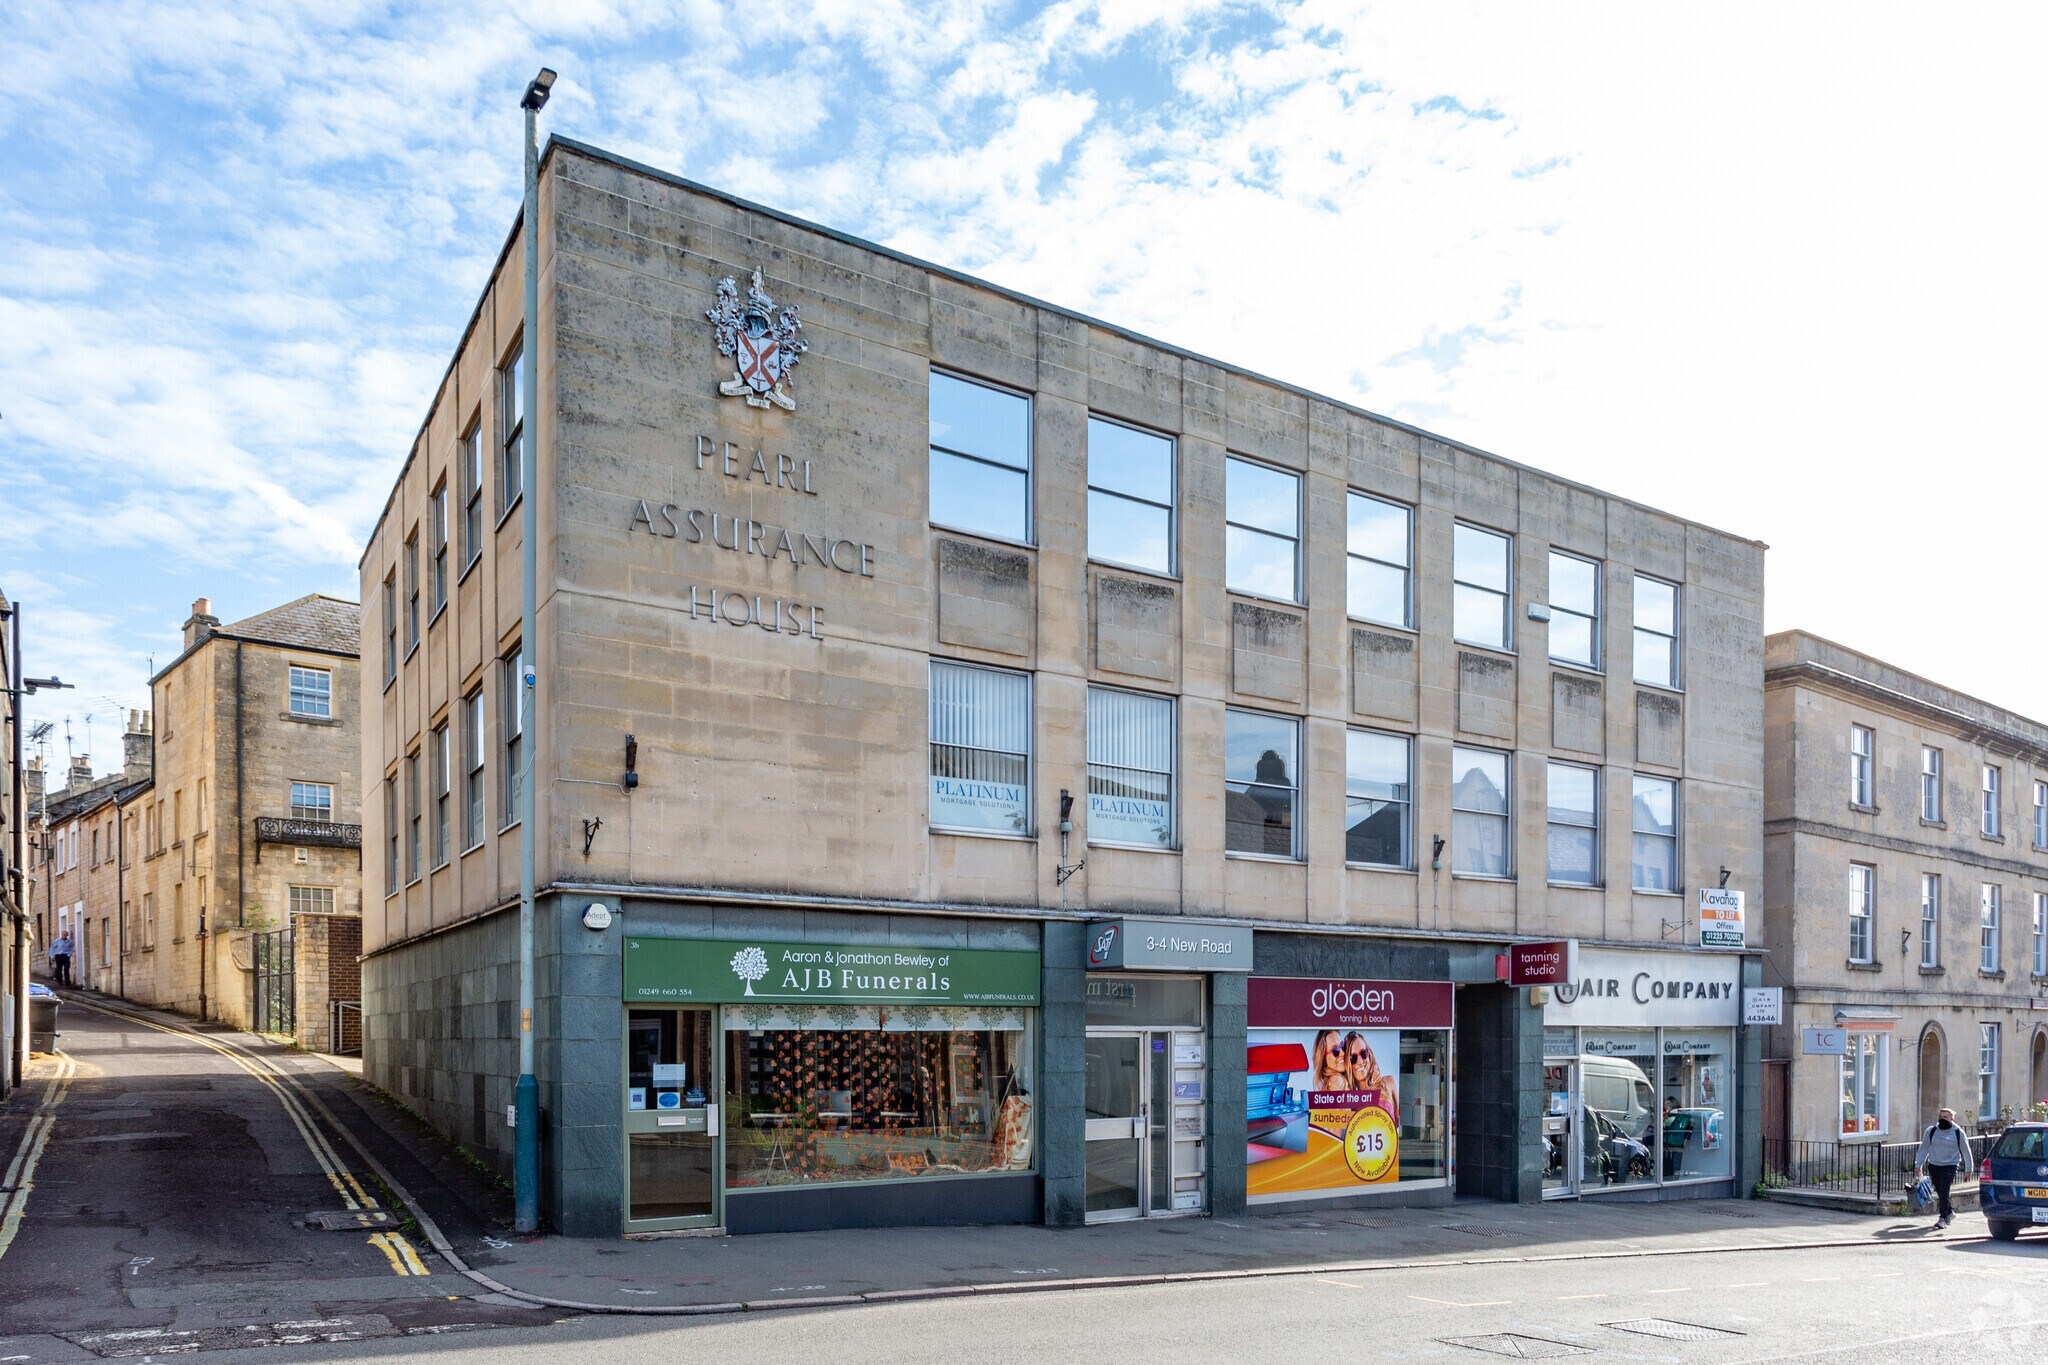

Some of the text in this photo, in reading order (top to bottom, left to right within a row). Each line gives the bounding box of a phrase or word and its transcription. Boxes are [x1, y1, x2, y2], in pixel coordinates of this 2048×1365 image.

[695, 434, 818, 496] PEARL
[629, 499, 875, 578] ASSURANCE
[689, 585, 824, 641] HOUSE
[936, 780, 1019, 802] PLATINUM
[940, 797, 1015, 810] MORTGAGE SOLUTIONS
[1092, 798, 1164, 817] PLATINUM
[1095, 813, 1161, 825] MORTGAGE SOLUTIONS
[1715, 911, 1735, 920] TO LET
[1716, 922, 1734, 930] Offices
[1705, 932, 1723, 940] 01225
[1147, 936, 1232, 954] 3-4 New Road
[782, 949, 950, 969] Aaron & Jonathon Bewley of
[1521, 950, 1560, 964] tanning
[1525, 963, 1556, 976] studio
[782, 968, 950, 992] AJB Funerals
[638, 988, 692, 996] 01249 660 554
[1311, 983, 1395, 1018] glöden
[1340, 1014, 1390, 1024] tanning & beauty
[1816, 1032, 1834, 1047] tc
[1314, 1092, 1372, 1104] State of the art
[1314, 1113, 1351, 1124] sunbeds
[1349, 1110, 1374, 1136] Automated
[1375, 1110, 1389, 1124] Spray
[1357, 1133, 1384, 1153] £15
[1353, 1154, 1391, 1177] Now Available
